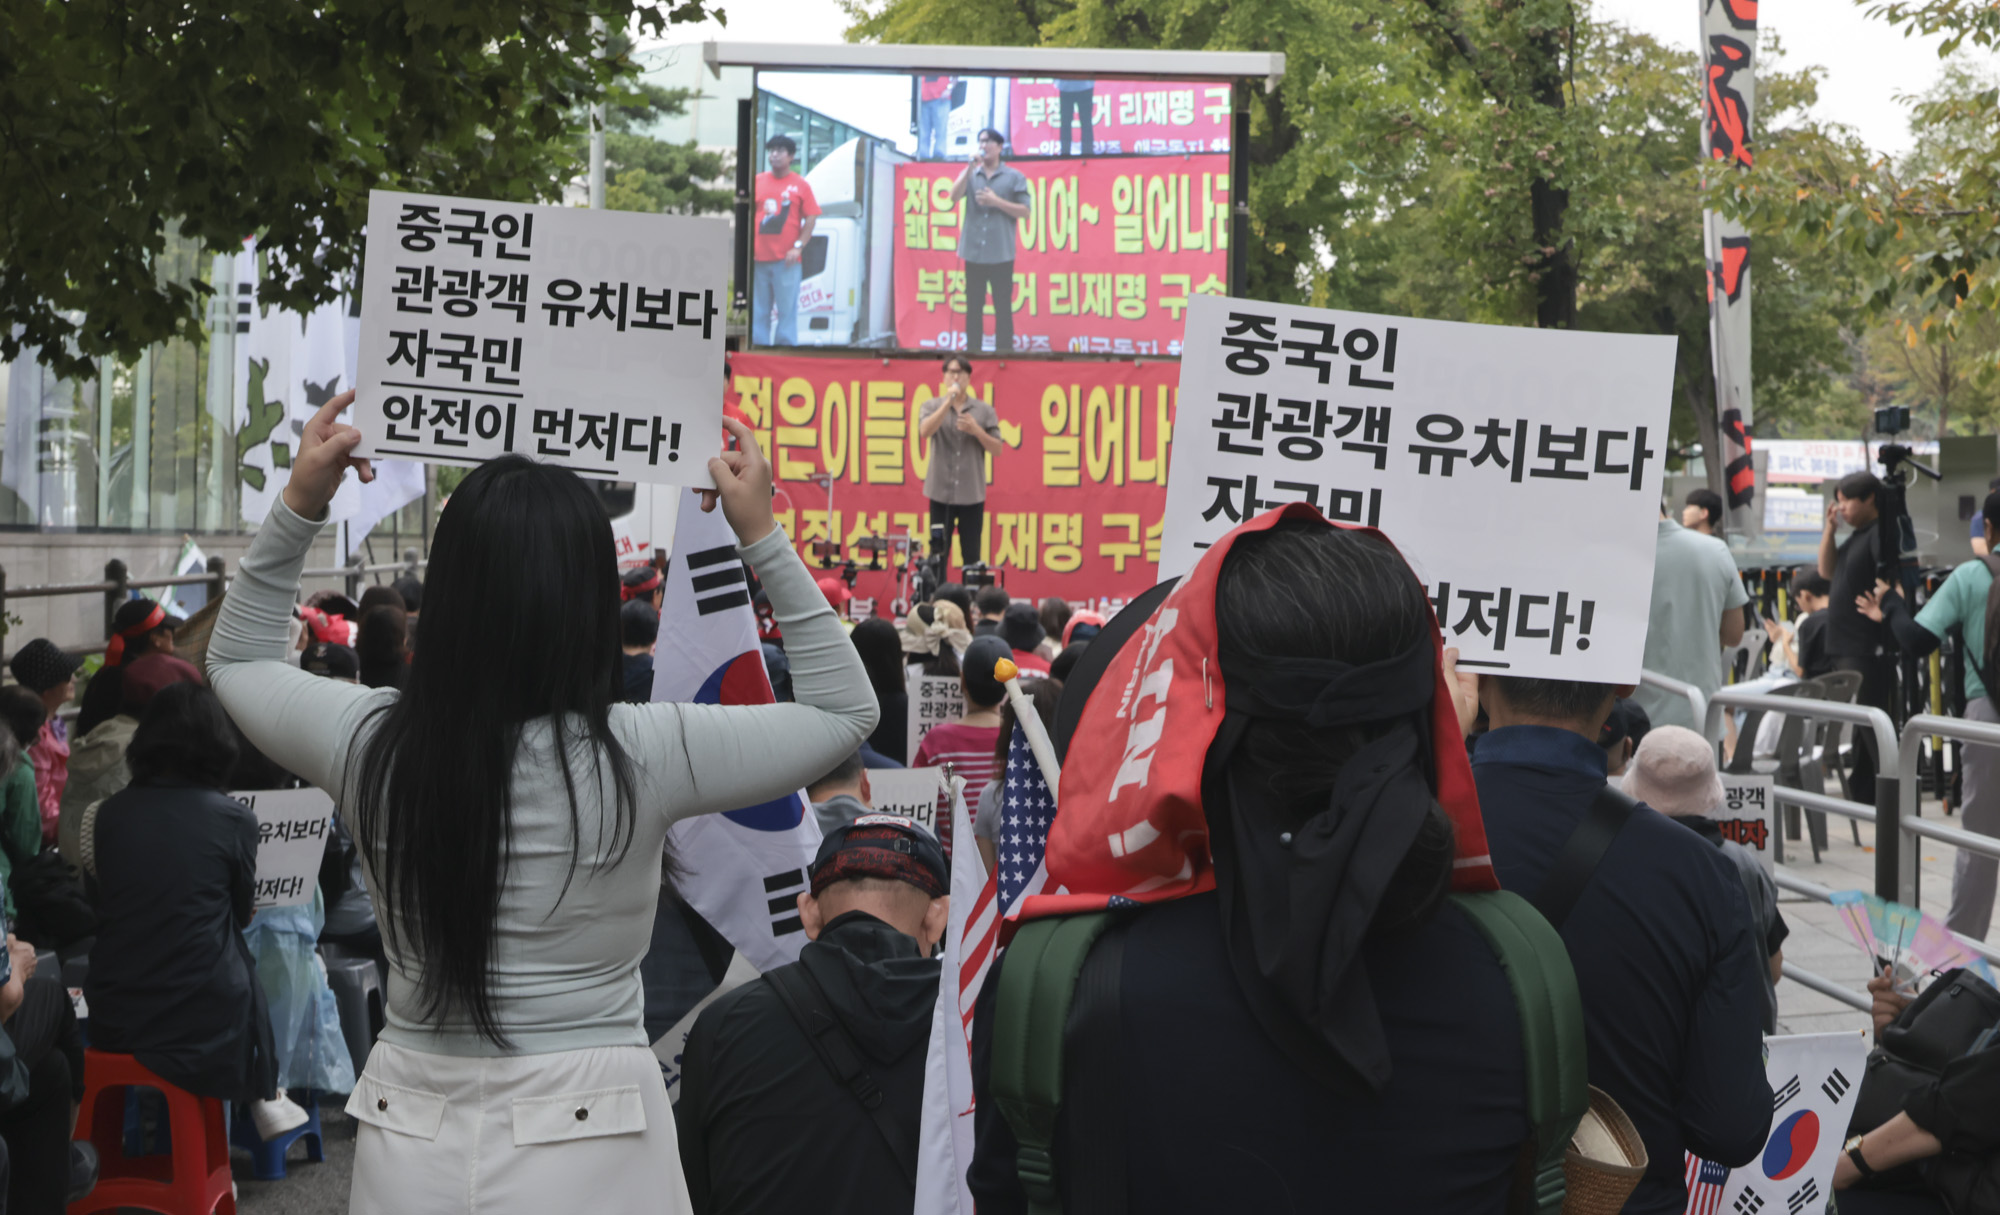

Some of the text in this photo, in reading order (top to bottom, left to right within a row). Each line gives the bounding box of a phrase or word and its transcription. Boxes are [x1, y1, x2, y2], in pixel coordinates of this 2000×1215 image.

[1025, 95, 1112, 128] 부정거
[1118, 89, 1195, 126] 리재명
[396, 203, 534, 261] 중국인
[903, 172, 1100, 253] 젊은이여~
[391, 265, 719, 340] 관광객 유치보다
[916, 268, 1037, 317] 부정거
[1049, 272, 1148, 320] 리재명
[386, 328, 523, 386] 자국민
[1220, 311, 1398, 390] 중국인
[381, 394, 517, 453] 안전이
[532, 408, 682, 465] 먼저다!
[734, 375, 1179, 487] 젊은이들이~ 일어나
[1211, 392, 1392, 470] 관광객
[1408, 413, 1654, 492] 유치보다
[919, 701, 964, 719] 관광객
[258, 817, 327, 844] 유치보다
